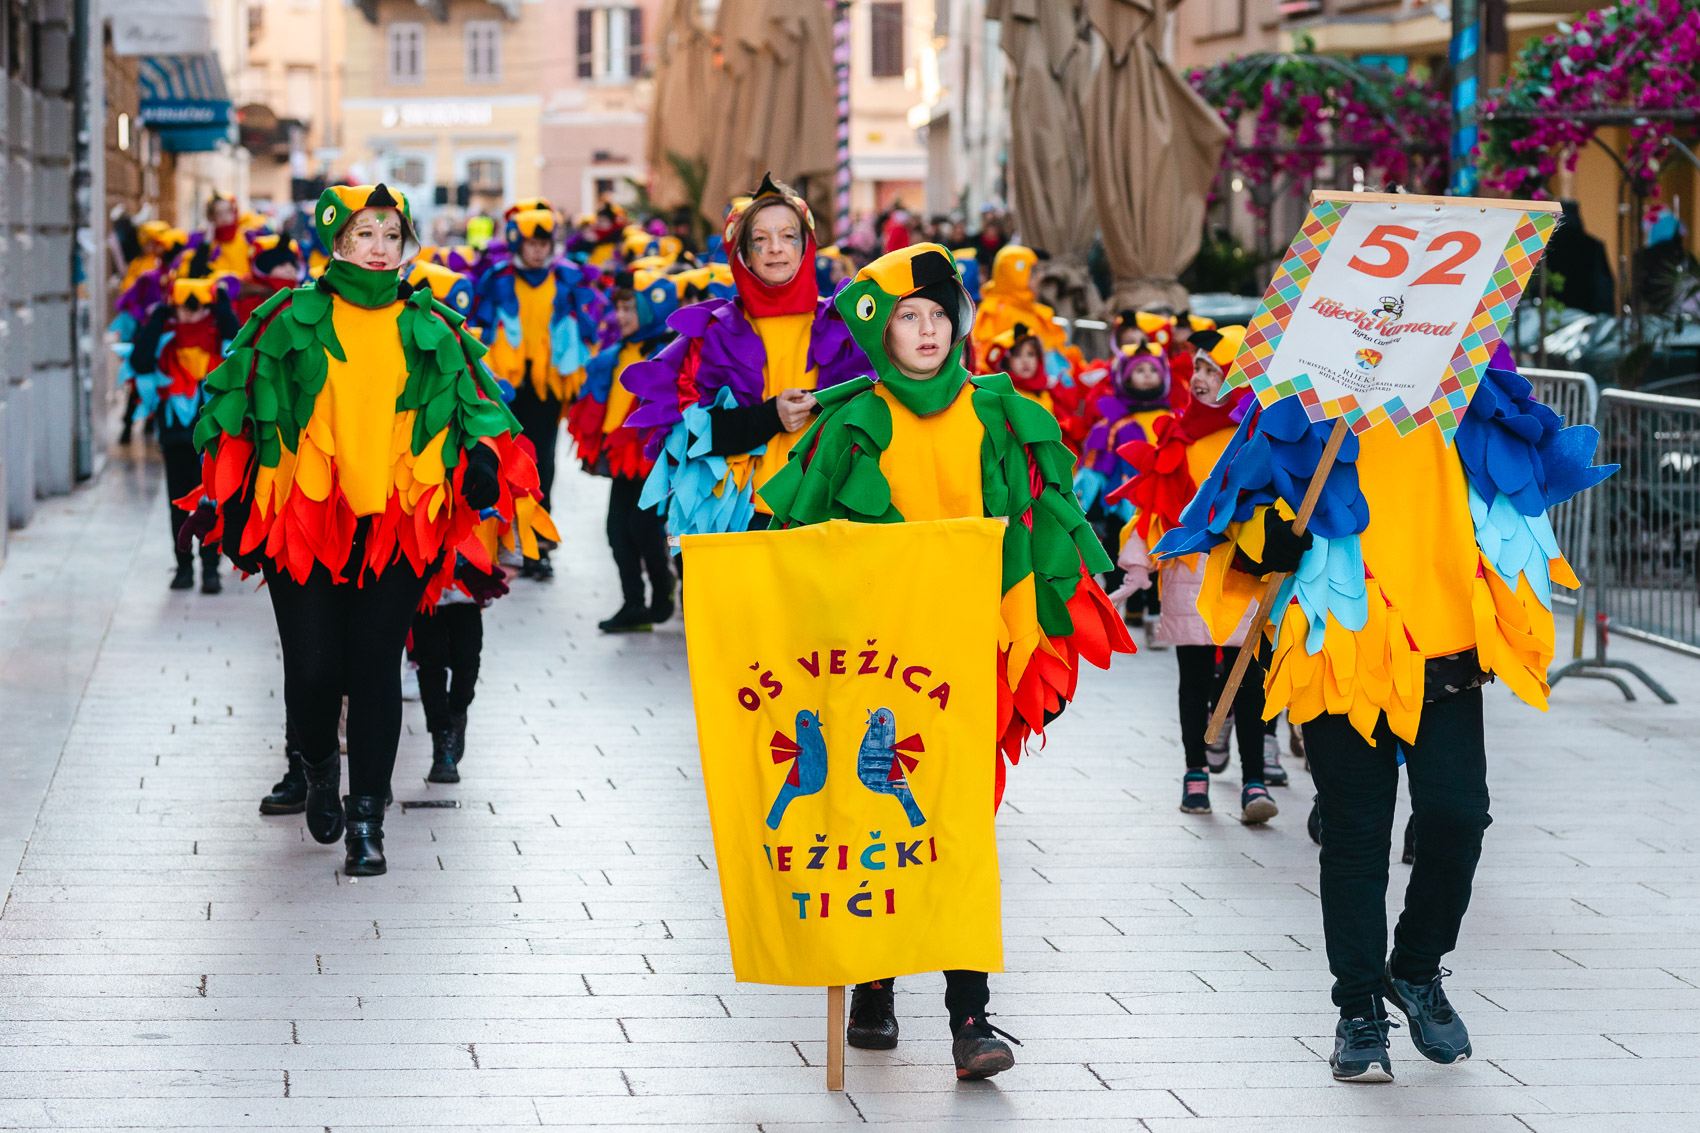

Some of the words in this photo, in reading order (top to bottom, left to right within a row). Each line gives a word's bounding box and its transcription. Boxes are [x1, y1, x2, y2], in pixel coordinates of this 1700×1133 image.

[1347, 224, 1482, 287] 52
[738, 661, 783, 712] OŠ
[797, 639, 951, 711] VEŽICA
[792, 880, 896, 920] TIĆI
